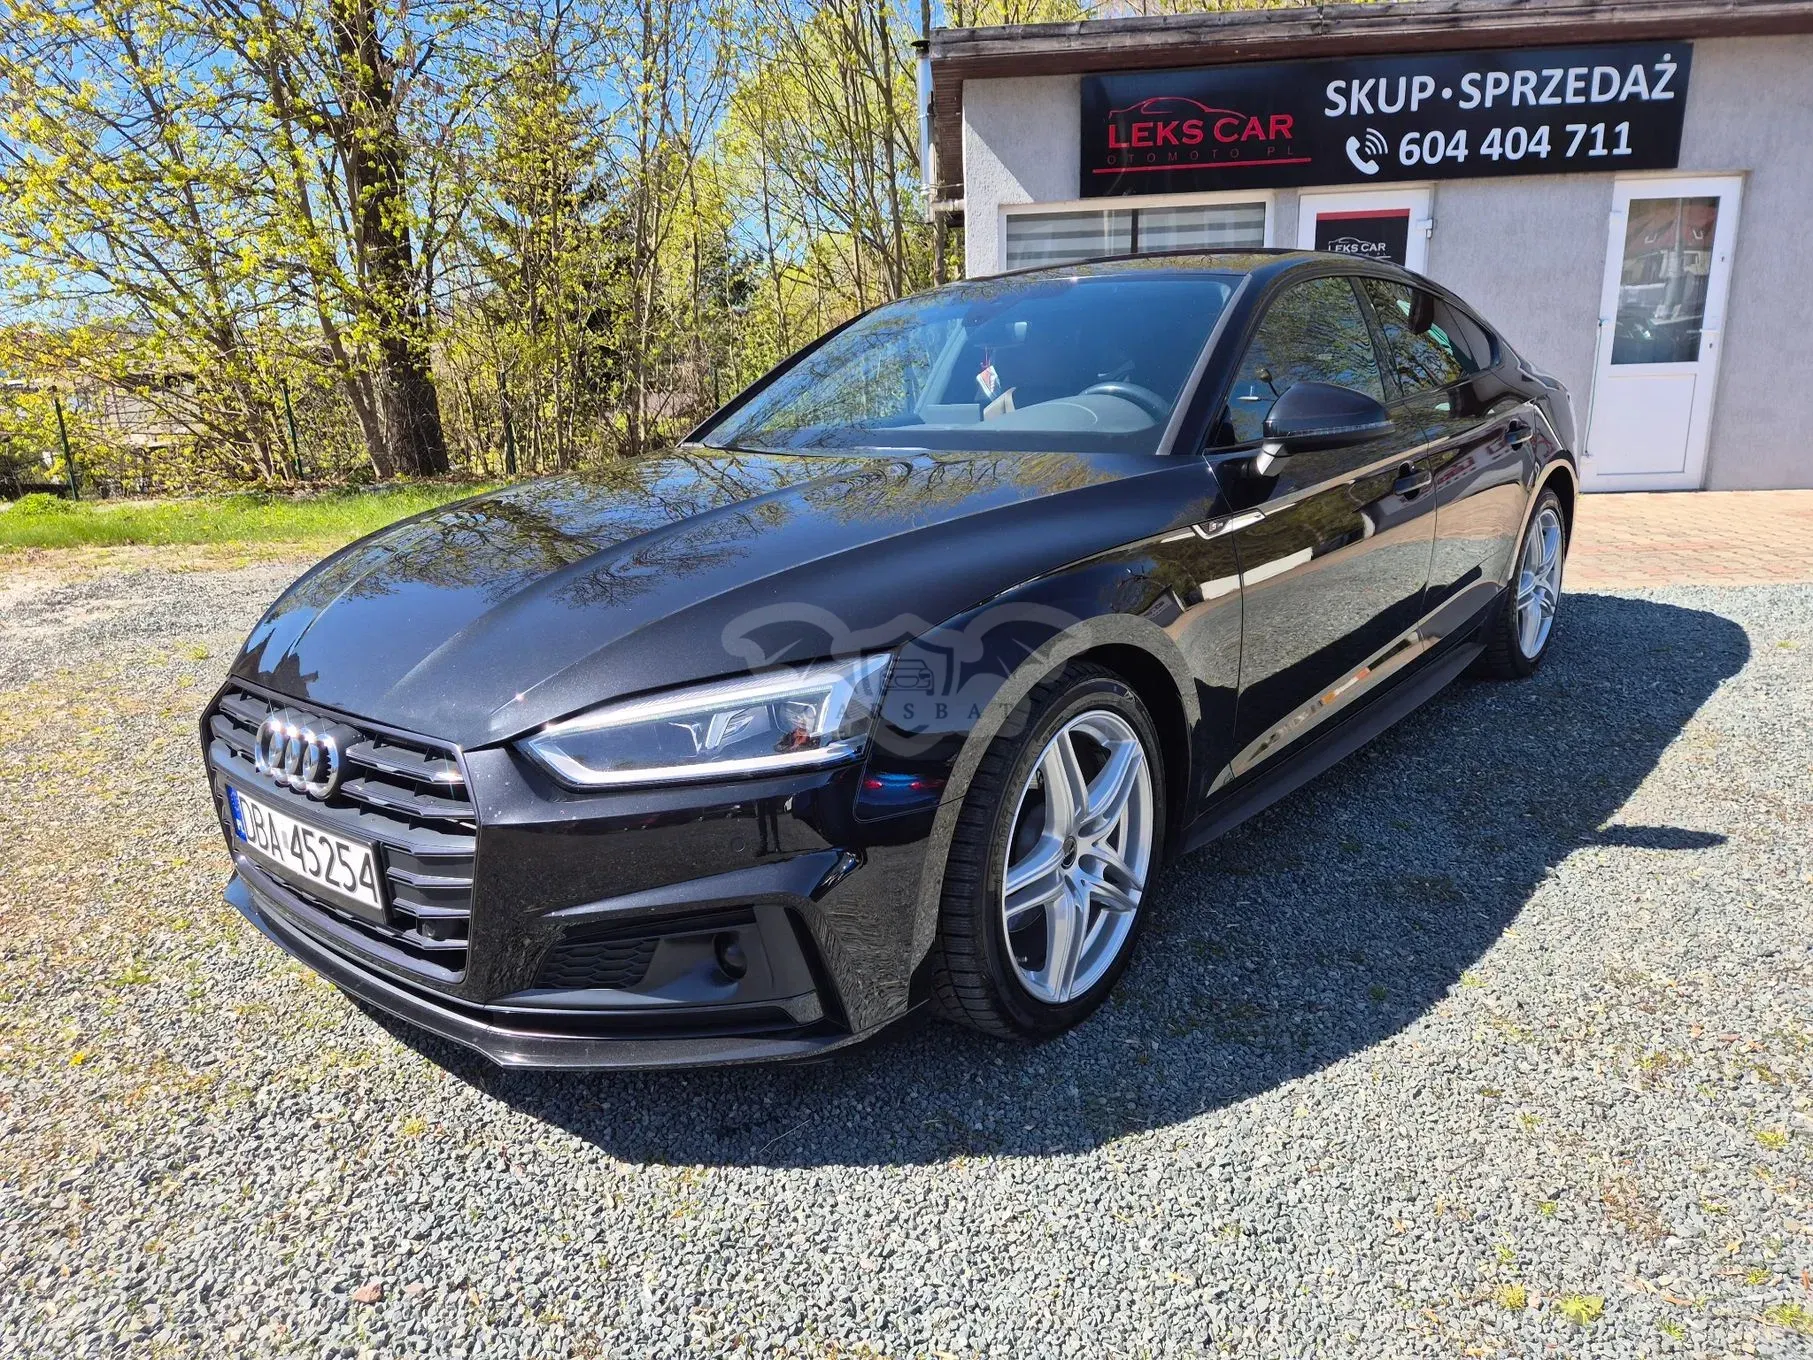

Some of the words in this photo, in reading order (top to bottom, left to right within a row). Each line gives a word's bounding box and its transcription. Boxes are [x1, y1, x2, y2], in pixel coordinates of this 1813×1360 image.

[1324, 75, 1435, 117] SKUP
[1458, 53, 1678, 110] SPRZEDAŻ
[1108, 116, 1205, 149] LEKS
[1213, 113, 1294, 143] CAR
[1399, 129, 1468, 166] 604
[1480, 125, 1551, 161] 404
[1565, 121, 1632, 158] 711
[1106, 148, 1241, 165] OTOMOTO
[1361, 242, 1386, 252] CAR
[239, 796, 285, 862] DBA
[290, 824, 378, 903] 45254
